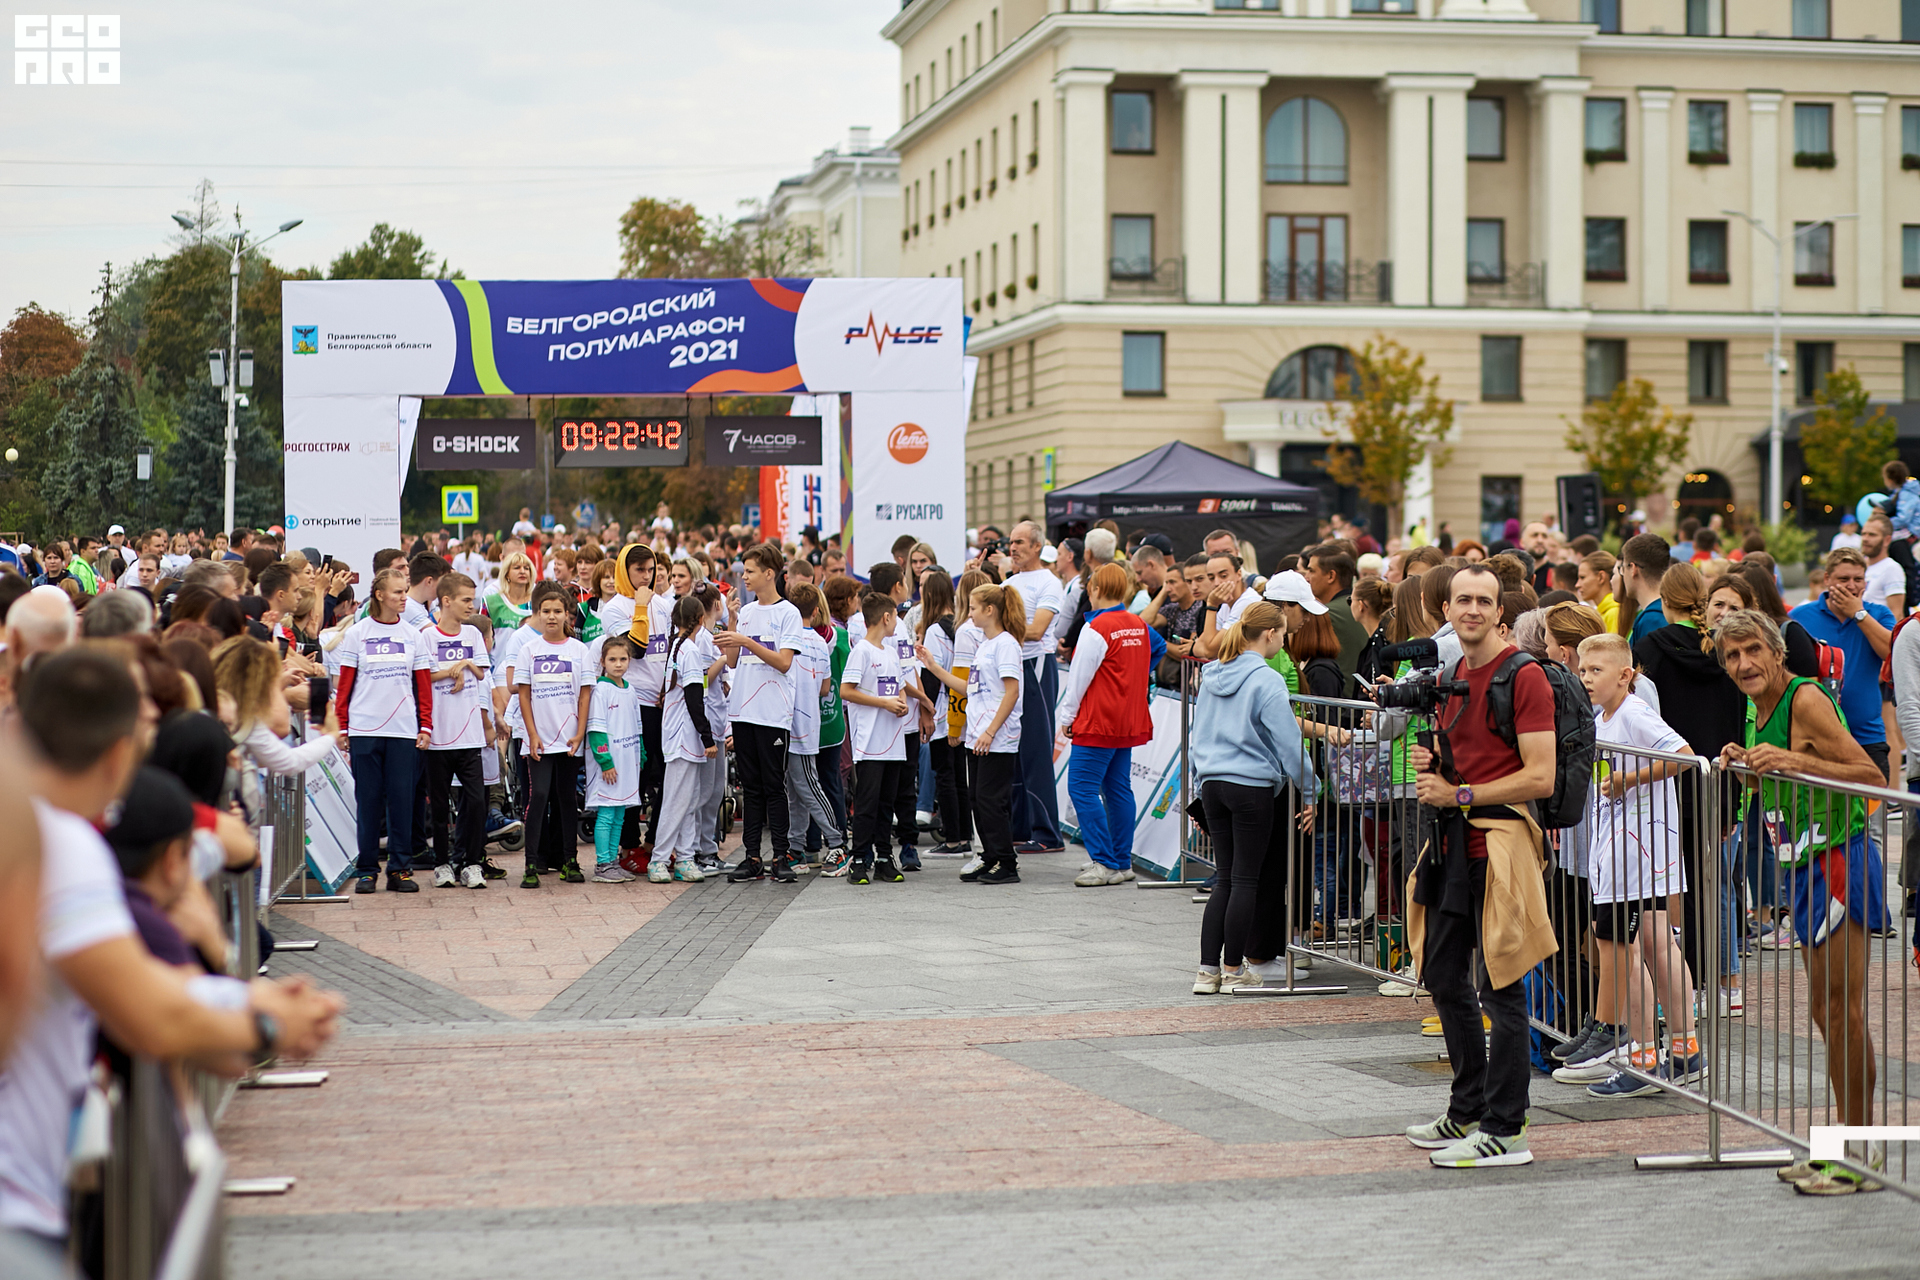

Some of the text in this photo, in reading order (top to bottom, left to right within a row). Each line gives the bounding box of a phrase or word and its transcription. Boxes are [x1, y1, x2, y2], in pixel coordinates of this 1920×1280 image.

[507, 287, 716, 335] БЕЛГОРОДСКИЙ
[327, 333, 397, 341] Правительство
[548, 316, 745, 361] ПОЛУМАРАФОН
[327, 342, 392, 351] Белгородской
[669, 339, 738, 368] 2021
[561, 420, 682, 452] 09:22:42
[742, 434, 797, 445] ЧАСОВ
[889, 426, 929, 449] Лето
[284, 442, 351, 452] РОСГОССТРАХ
[433, 435, 520, 453] G-SHOCK
[896, 503, 943, 520] РУСАГРО
[302, 517, 362, 528] открытие
[375, 643, 390, 654] 16
[654, 641, 666, 653] 19
[1397, 644, 1429, 658] RØDE
[445, 648, 464, 660] 08
[540, 661, 560, 673] 07
[884, 683, 897, 695] 37
